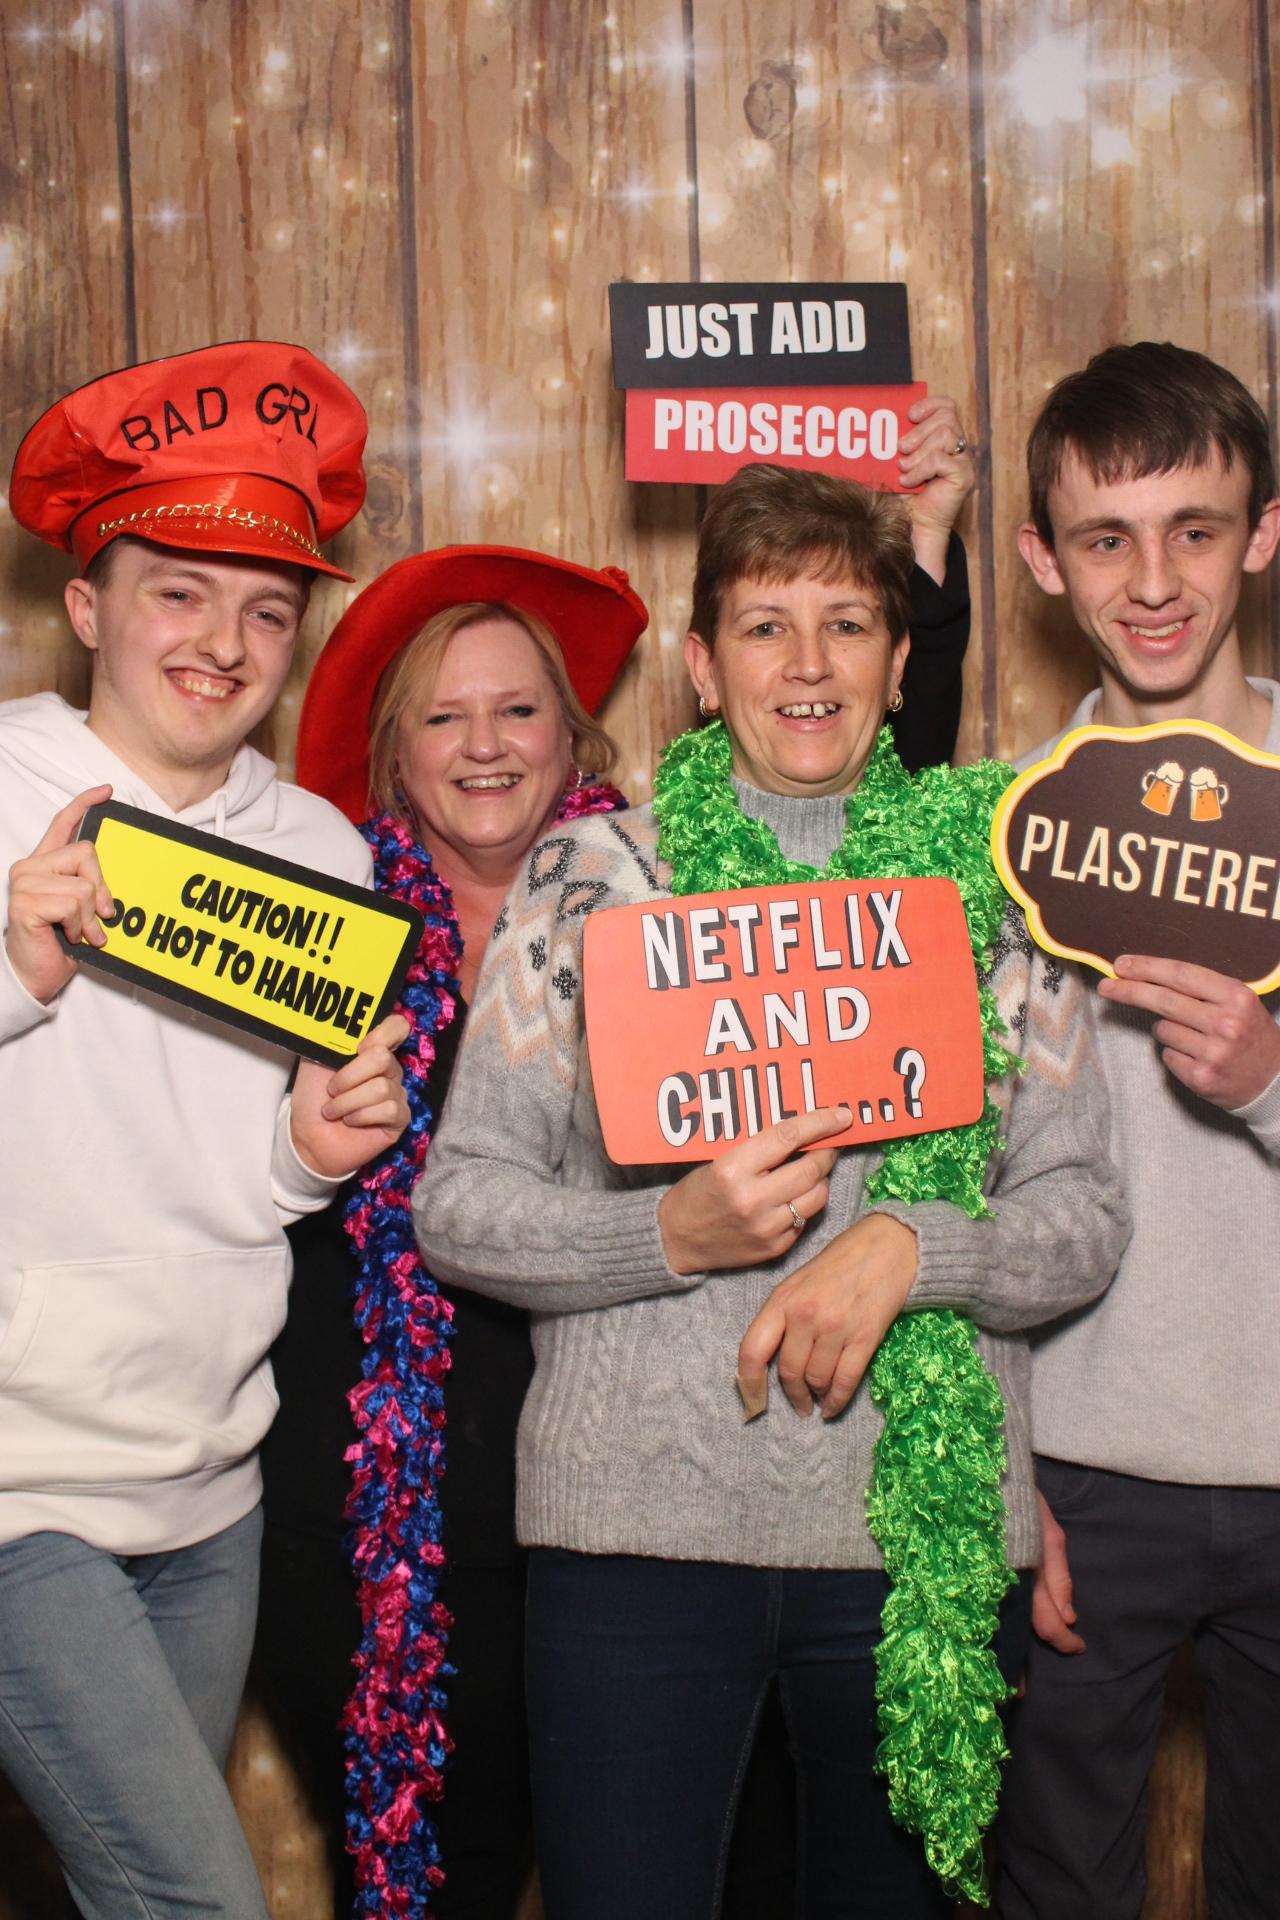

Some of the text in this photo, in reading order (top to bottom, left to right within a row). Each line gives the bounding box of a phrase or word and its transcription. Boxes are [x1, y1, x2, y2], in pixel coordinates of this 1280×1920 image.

[645, 300, 866, 359] JUST ADD
[120, 386, 228, 451] BAD
[654, 398, 898, 461] PROSECCO
[1019, 814, 1280, 921] PLASTERE
[180, 873, 345, 965] CAUTION!!
[640, 889, 912, 990] NETFLIX
[100, 898, 375, 1039] OO HOT TO HANDLE
[704, 986, 871, 1056] AND
